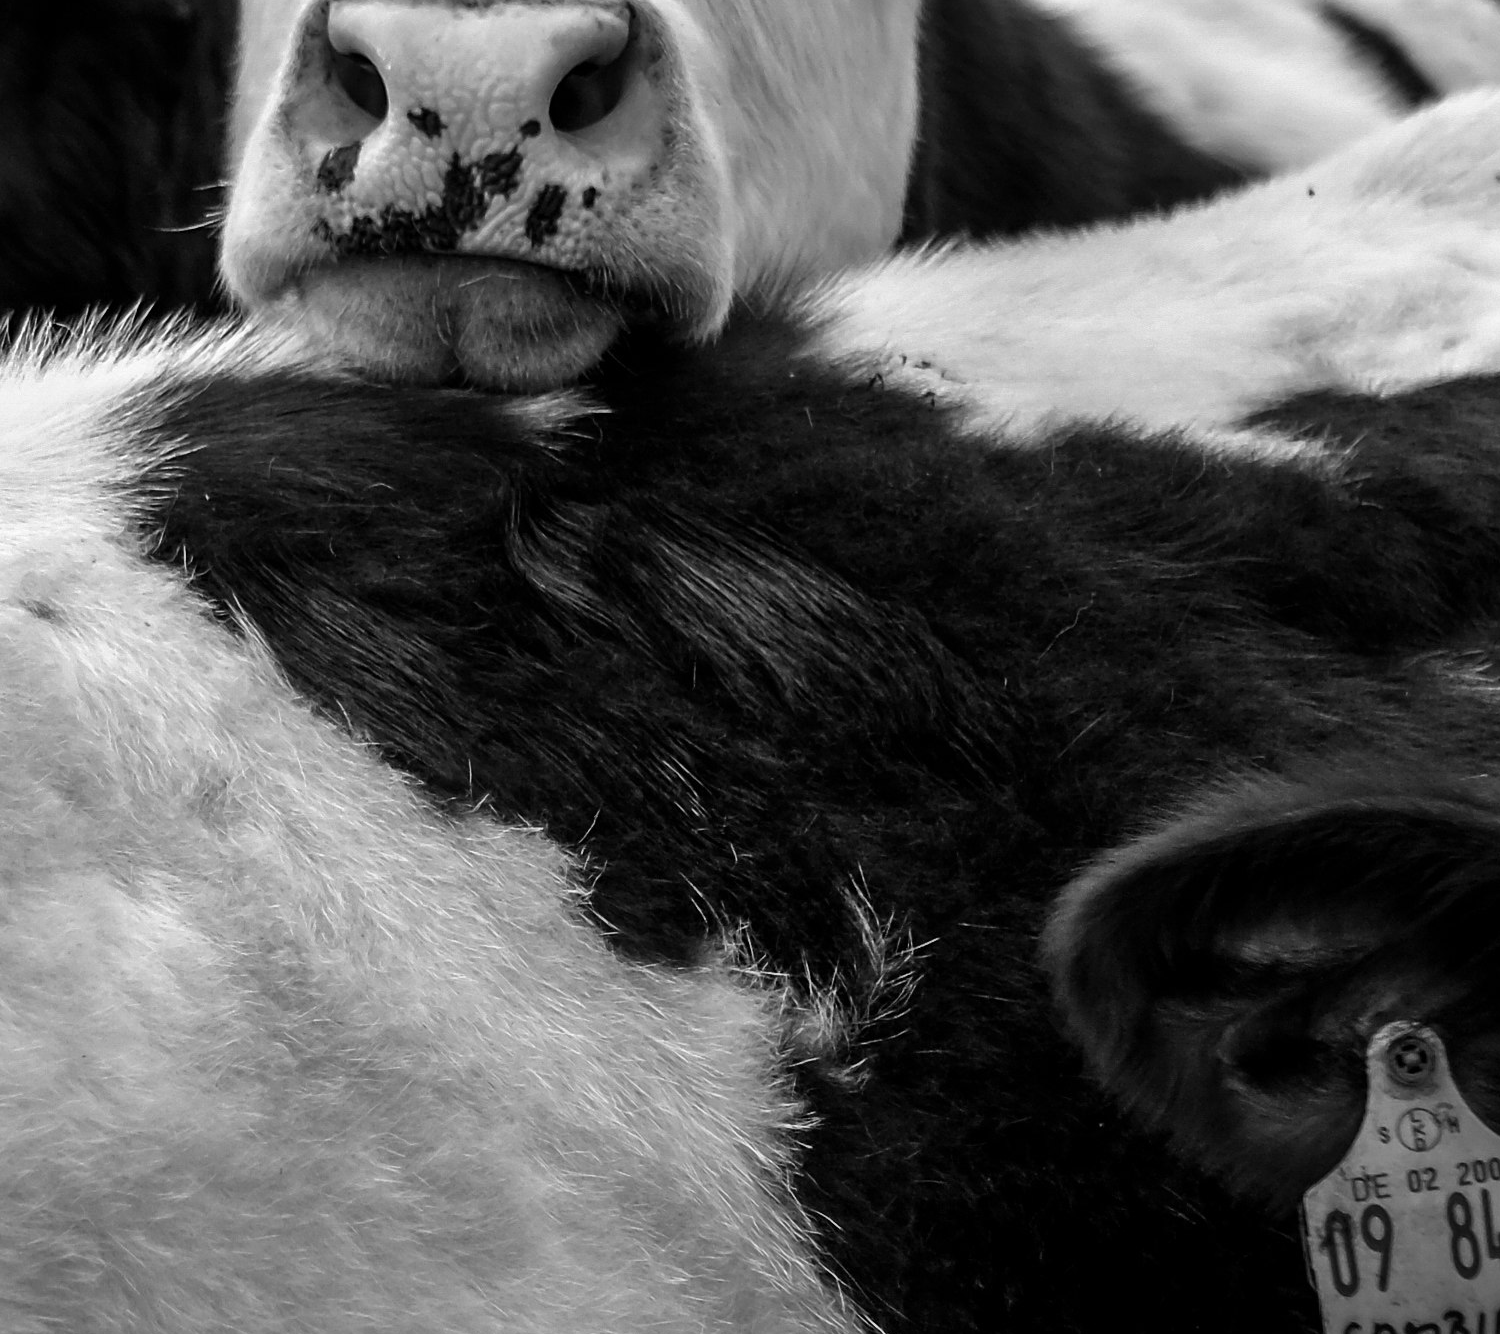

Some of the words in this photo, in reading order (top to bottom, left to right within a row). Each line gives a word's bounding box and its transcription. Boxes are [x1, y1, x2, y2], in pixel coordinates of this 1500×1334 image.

[1352, 1172, 1393, 1203] DE
[1407, 1167, 1441, 1194] 02
[1323, 1203, 1393, 1298] 09
